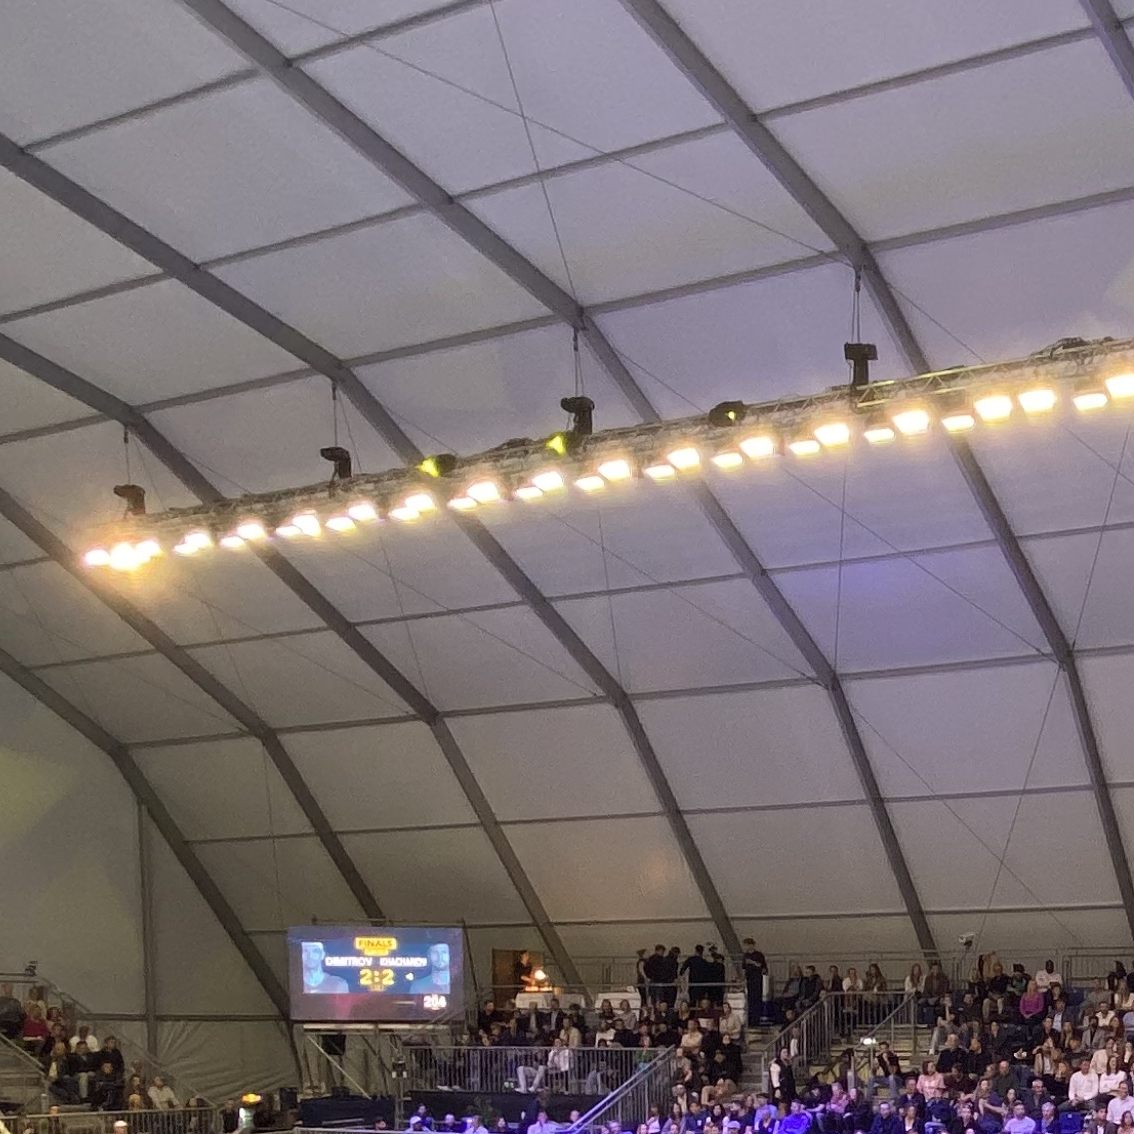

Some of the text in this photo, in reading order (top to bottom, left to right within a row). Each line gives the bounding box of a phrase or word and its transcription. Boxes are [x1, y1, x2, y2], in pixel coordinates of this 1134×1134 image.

[358, 940, 393, 948] FINALS
[359, 969, 395, 986] 2:2
[423, 996, 447, 1008] 204
